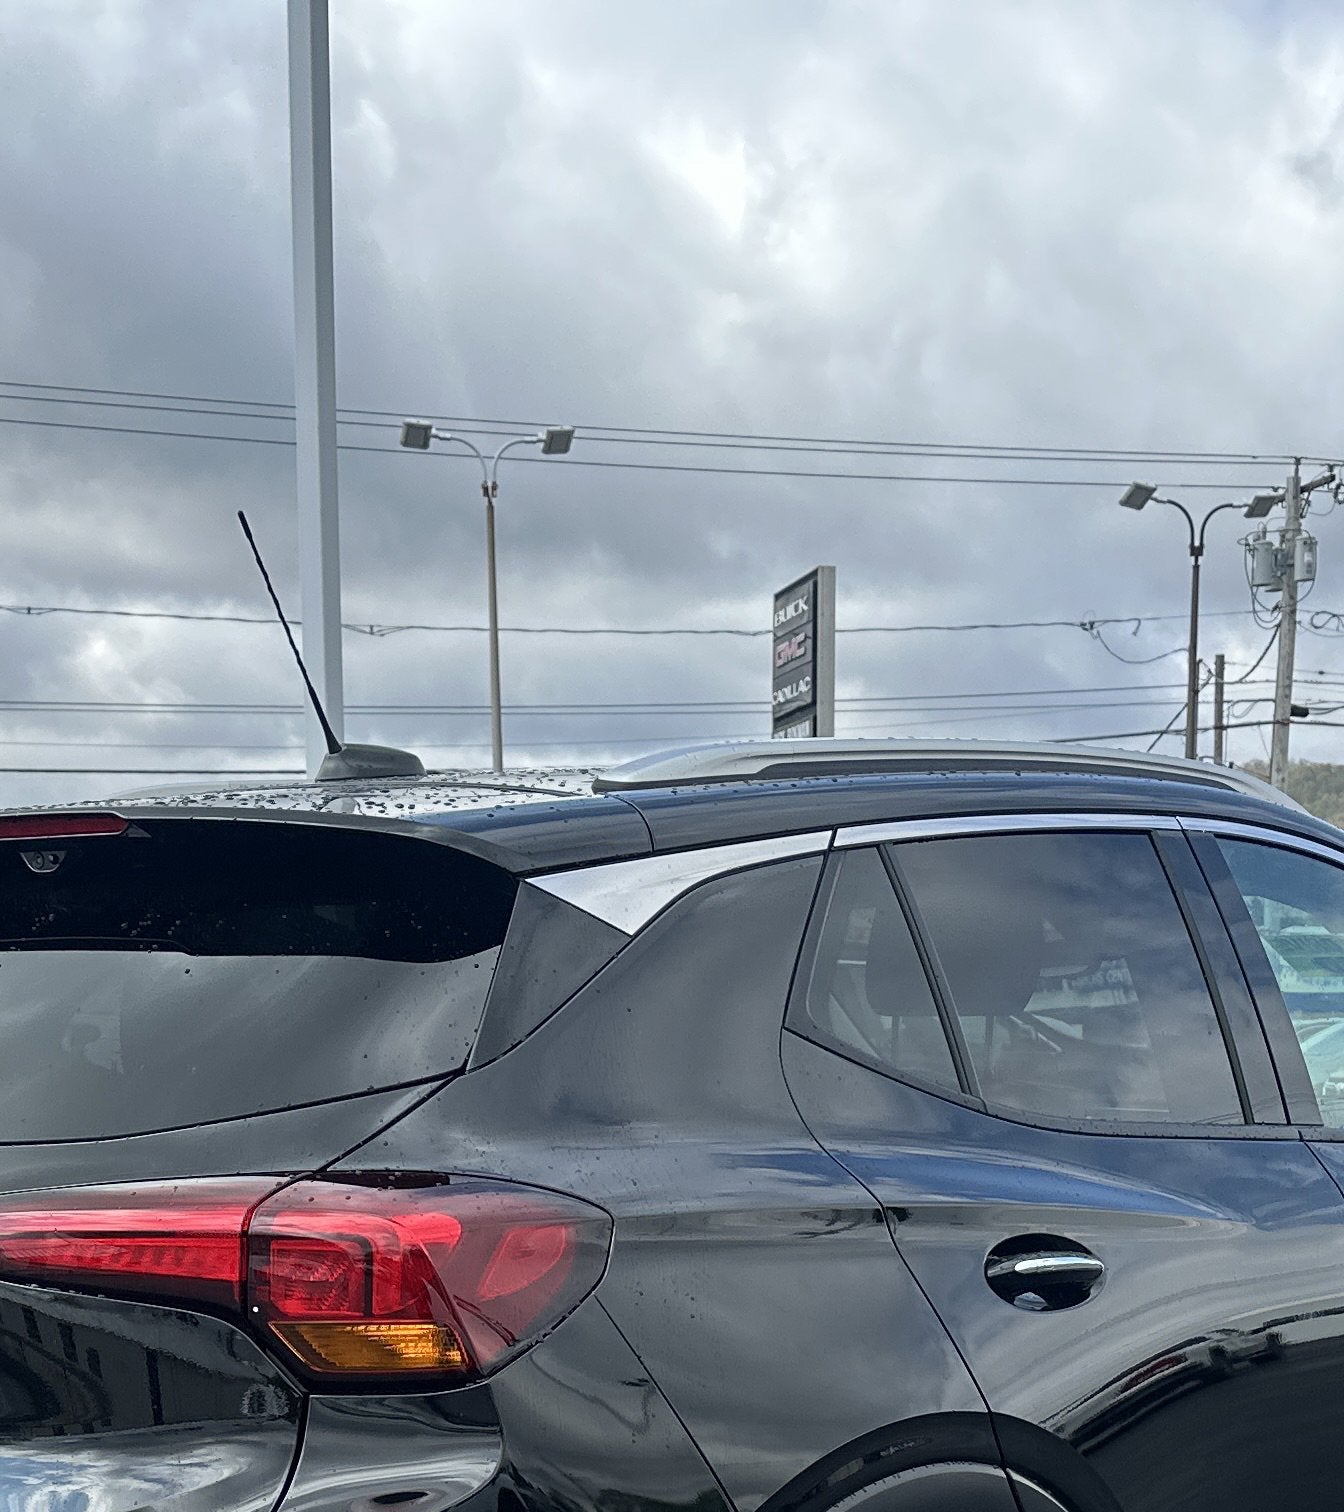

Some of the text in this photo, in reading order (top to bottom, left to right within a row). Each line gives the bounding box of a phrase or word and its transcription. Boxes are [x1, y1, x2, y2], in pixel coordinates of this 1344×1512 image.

[774, 595, 808, 627] BUICK
[775, 632, 806, 668] GMC
[772, 676, 811, 706] CADILLAC
